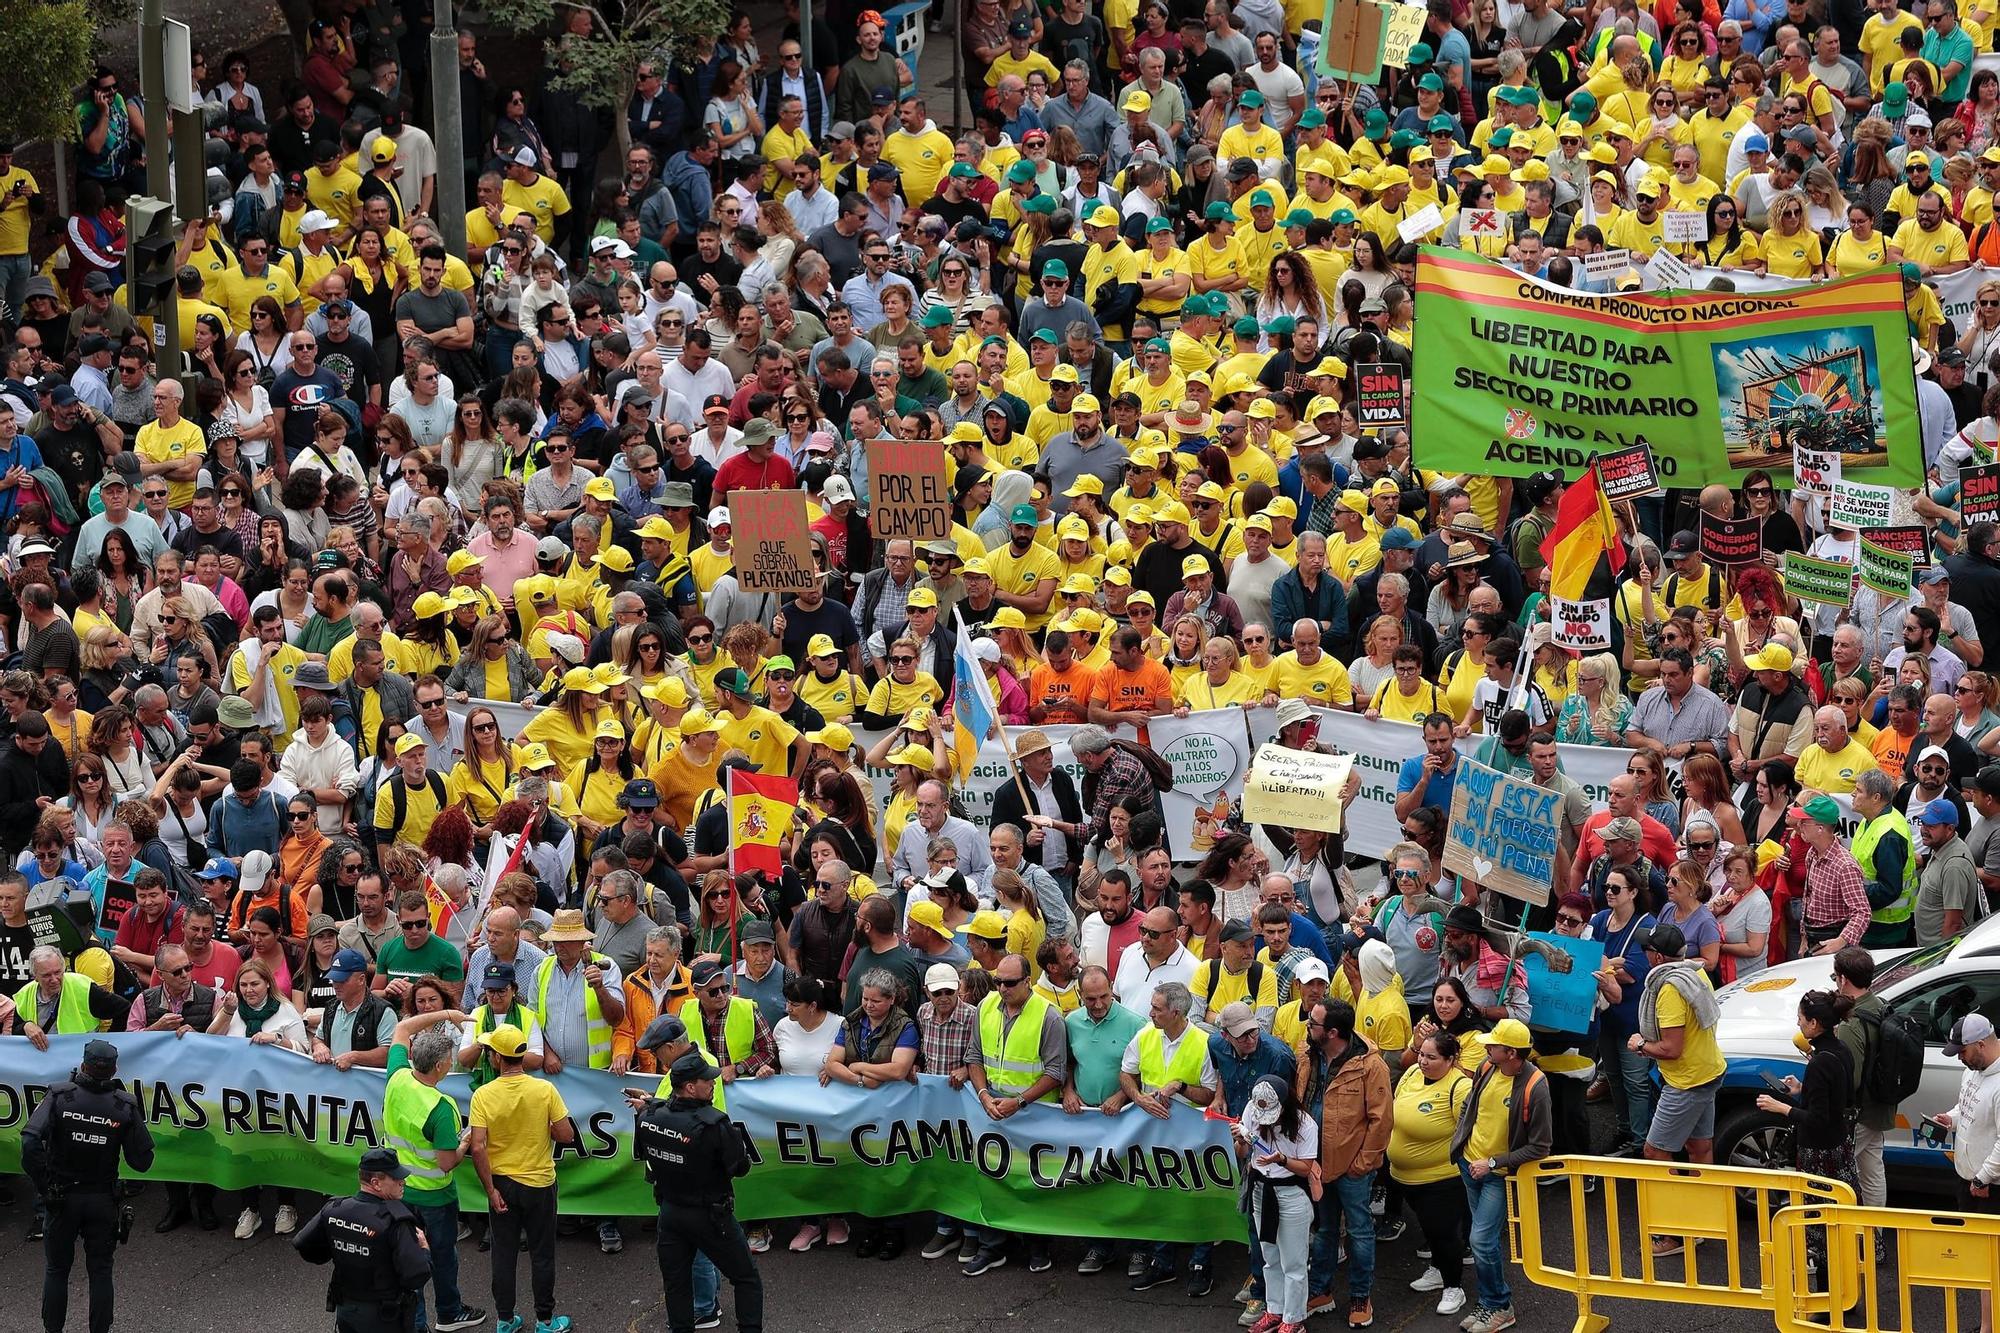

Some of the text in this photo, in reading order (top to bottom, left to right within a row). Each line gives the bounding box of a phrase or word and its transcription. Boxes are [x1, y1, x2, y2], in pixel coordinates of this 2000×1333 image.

[1383, 47, 1404, 62] ADA
[1599, 297, 1687, 323] PRODUCTO
[1692, 300, 1799, 321] NACIONAL
[1470, 317, 1672, 365] LIBERTAD PARA
[1508, 353, 1632, 391] NUESTRO
[1361, 375, 1398, 391] SIN
[1453, 367, 1698, 417] SECTOR PRIMARIO
[1379, 399, 1400, 407] HAY
[1362, 407, 1401, 419] VIDA
[1544, 420, 1585, 440] NO
[1593, 430, 1612, 445] A
[1484, 440, 1598, 468] AGENDA
[1812, 454, 1827, 463] EL
[1616, 471, 1650, 486] VENDES
[1801, 467, 1822, 483] NO
[879, 474, 944, 504] POR EL
[1834, 484, 1890, 501] EL CAMPO
[1963, 475, 1998, 497] SIN
[1846, 497, 1856, 506] SE
[1857, 499, 1890, 510] VENDE
[1963, 493, 1999, 505] EL CAMPO
[1964, 500, 1999, 513] NO HAY
[1833, 502, 1890, 518] EL CAMPO SE
[1963, 510, 2000, 526] VIDA
[877, 507, 946, 538] CAMPO
[1832, 511, 1889, 527] DEFIENDE
[1703, 527, 1758, 544] GOBIERNO
[1864, 530, 1922, 540] SÁNCHEZ
[759, 540, 786, 554] QUE
[1703, 537, 1758, 555] TRAIDOR
[753, 554, 798, 570] SOBRAN
[1861, 546, 1909, 573] PRECIOS
[743, 569, 813, 588] PLÁTANOS
[1788, 561, 1848, 580] LA SOCIEDAD
[1884, 570, 1908, 581] PARA
[1787, 570, 1848, 589] CIVIL CON LOS
[1869, 573, 1908, 591] CAMPO
[1786, 579, 1848, 598] AGRICULTORES
[1561, 603, 1597, 614] SIN EL
[1559, 611, 1600, 623] CAMPO
[1565, 622, 1591, 636] NO
[1555, 632, 1605, 644] HAY VIDA
[1048, 684, 1071, 693] SIN
[1121, 686, 1145, 695] SIN
[1184, 736, 1215, 748] NO AL
[1165, 749, 1218, 762] MALTRATO
[1185, 761, 1212, 772] A LOS
[1172, 771, 1227, 785] ANADEROS
[1456, 760, 1559, 824] AQUÍ ESTÁ
[1450, 820, 1475, 849] NO
[1491, 806, 1557, 855] FUERZA
[30, 920, 54, 933] VIRUS
[1529, 993, 1587, 1017] EFIENDE
[62, 1111, 113, 1126] POLICIA
[221, 1087, 386, 1149] RENTA
[774, 1119, 837, 1166] EL
[1028, 1143, 1235, 1190] CANARIO
[640, 1120, 684, 1141] POLICIA
[328, 1216, 369, 1236] POLICIA
